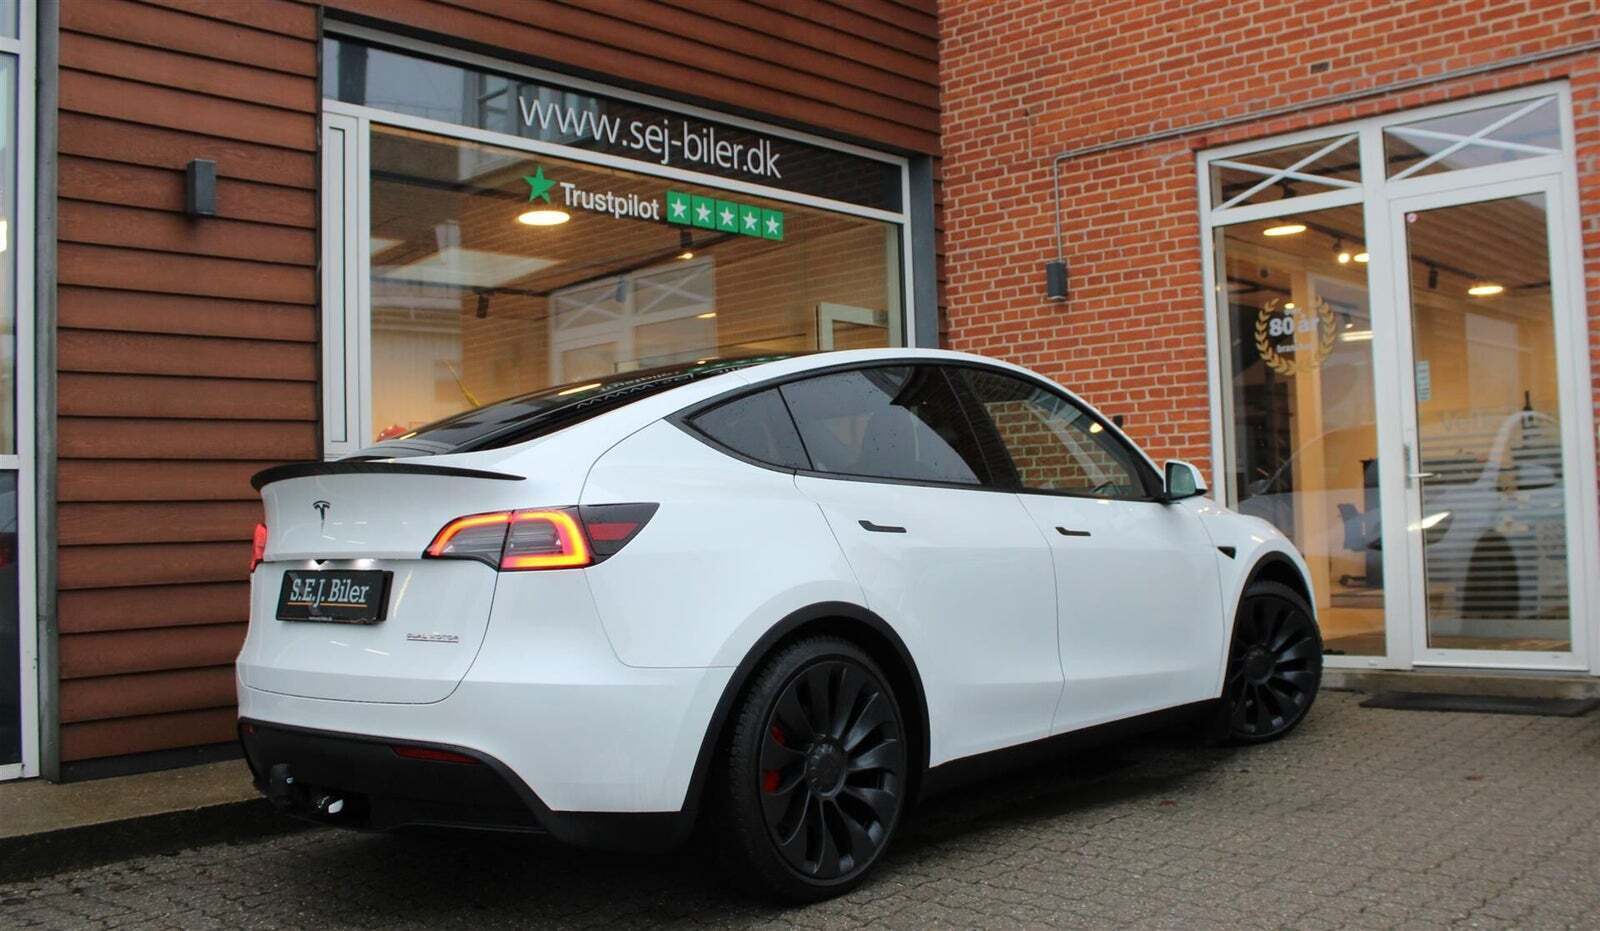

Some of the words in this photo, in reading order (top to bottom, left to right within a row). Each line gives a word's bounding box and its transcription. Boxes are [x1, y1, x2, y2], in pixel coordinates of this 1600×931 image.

[519, 96, 782, 179] www.sej-biler.dk
[560, 181, 660, 221] Trustpilot
[1269, 316, 1294, 337] 80
[290, 578, 325, 608] S.E.J.
[327, 578, 370, 603] Biler
